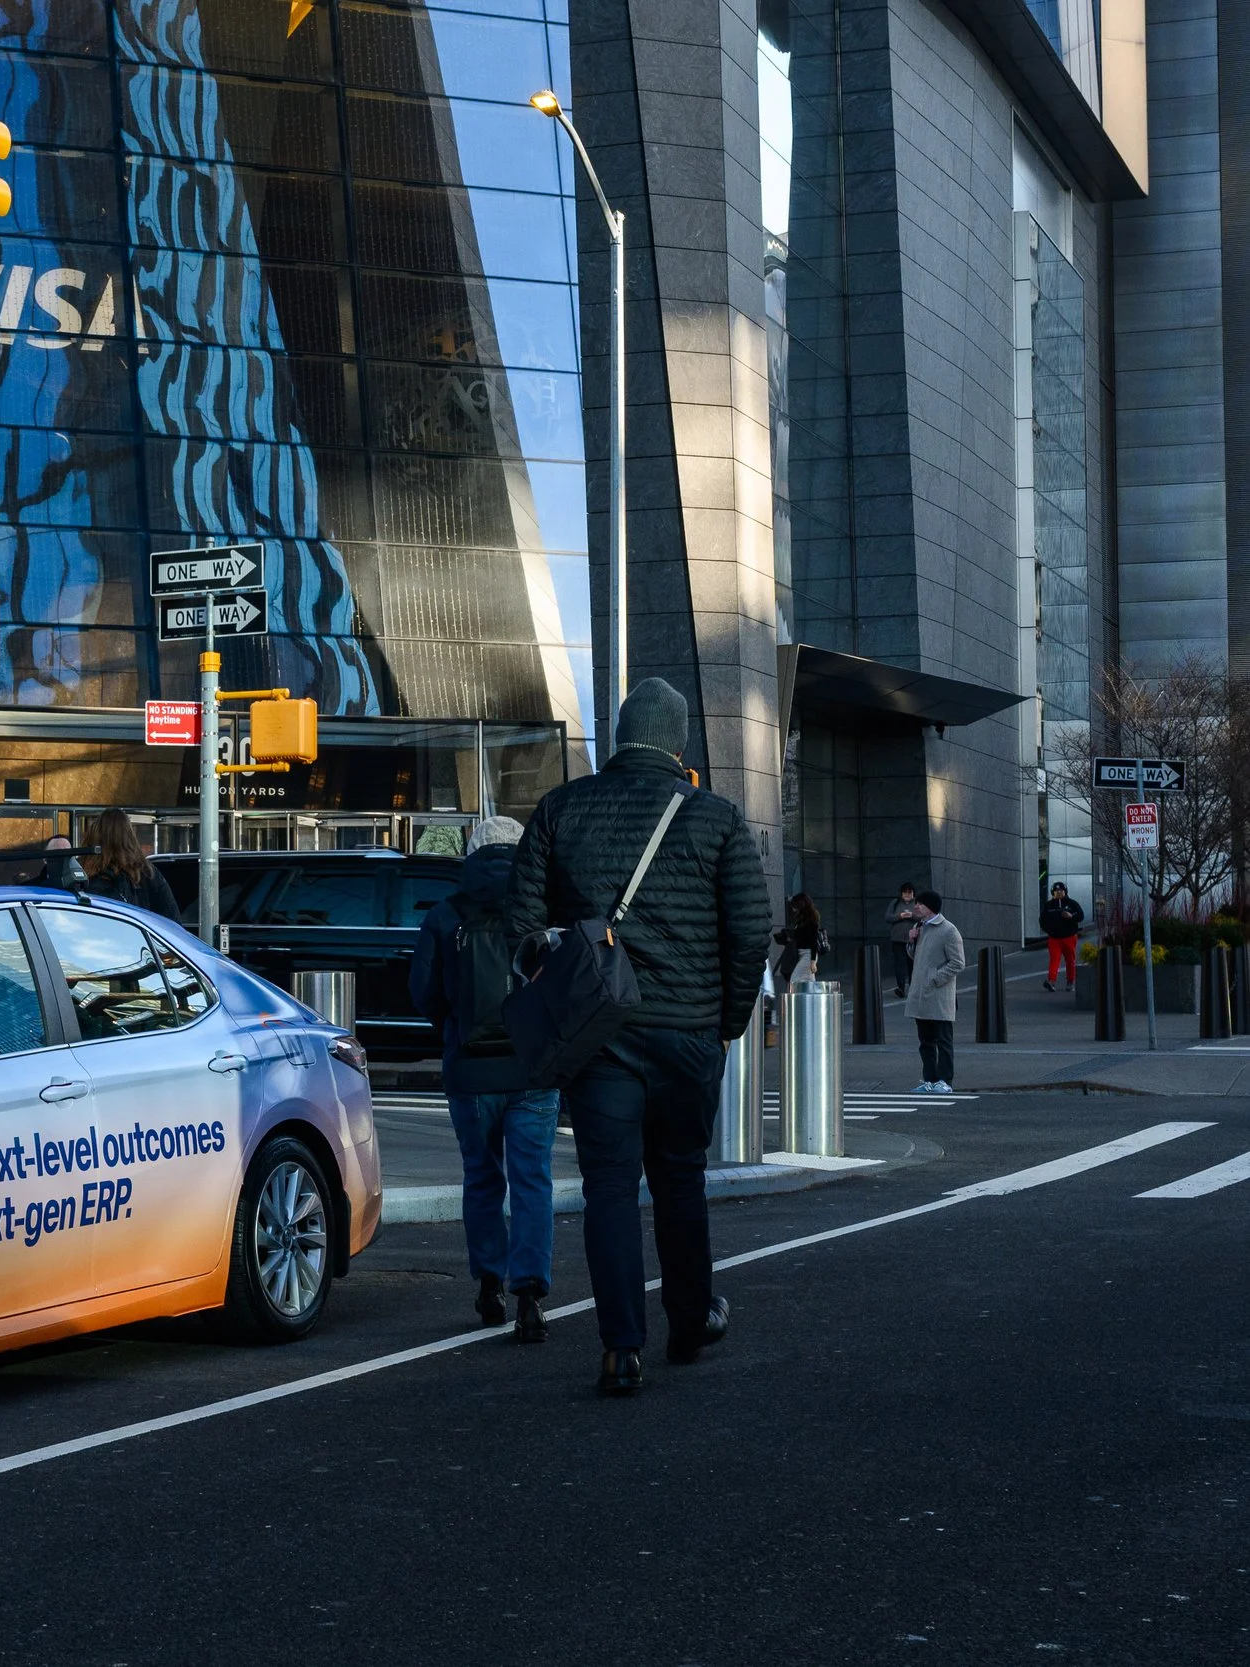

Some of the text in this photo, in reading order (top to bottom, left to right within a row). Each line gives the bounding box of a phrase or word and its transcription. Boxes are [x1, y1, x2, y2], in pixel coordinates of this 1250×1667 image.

[167, 559, 245, 581] ONE WAY
[175, 605, 251, 627] ONE WAY
[149, 705, 198, 715] NO STANDING
[149, 715, 181, 725] Anytime
[217, 736, 256, 777] 30
[1108, 767, 1172, 781] ONE WAY
[184, 786, 285, 796] HUON YARDS
[1130, 807, 1154, 816] DO NOT
[1131, 815, 1152, 823] ENTER
[1131, 827, 1155, 835] WRONG
[760, 830, 769, 857] 30
[103, 1120, 225, 1166] outcomes
[79, 1177, 133, 1229] ERP.
